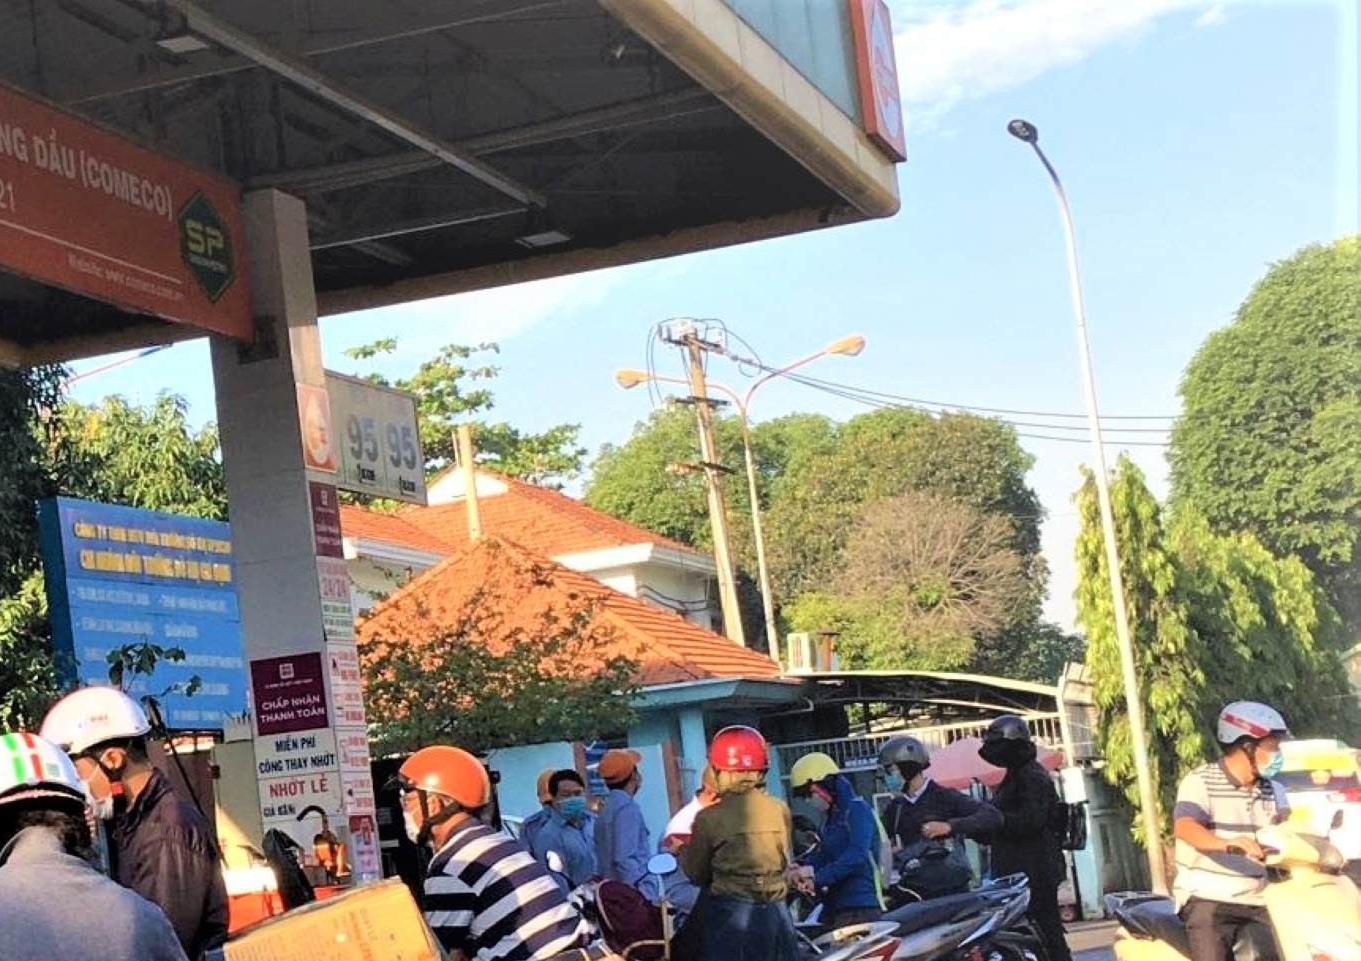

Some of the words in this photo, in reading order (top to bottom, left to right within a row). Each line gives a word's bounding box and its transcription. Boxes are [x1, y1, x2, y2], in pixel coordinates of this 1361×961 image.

[33, 128, 75, 178] DẦU
[79, 151, 173, 222] (COMECO)
[185, 218, 226, 257] SP
[346, 414, 379, 462] 95
[386, 422, 417, 470] 95
[260, 711, 295, 723] THANH
[296, 706, 325, 718] TOÁN
[262, 696, 290, 710] CHẤP
[301, 734, 317, 749] PHÍ
[258, 758, 284, 774] CÔNG
[284, 758, 308, 771] THAY
